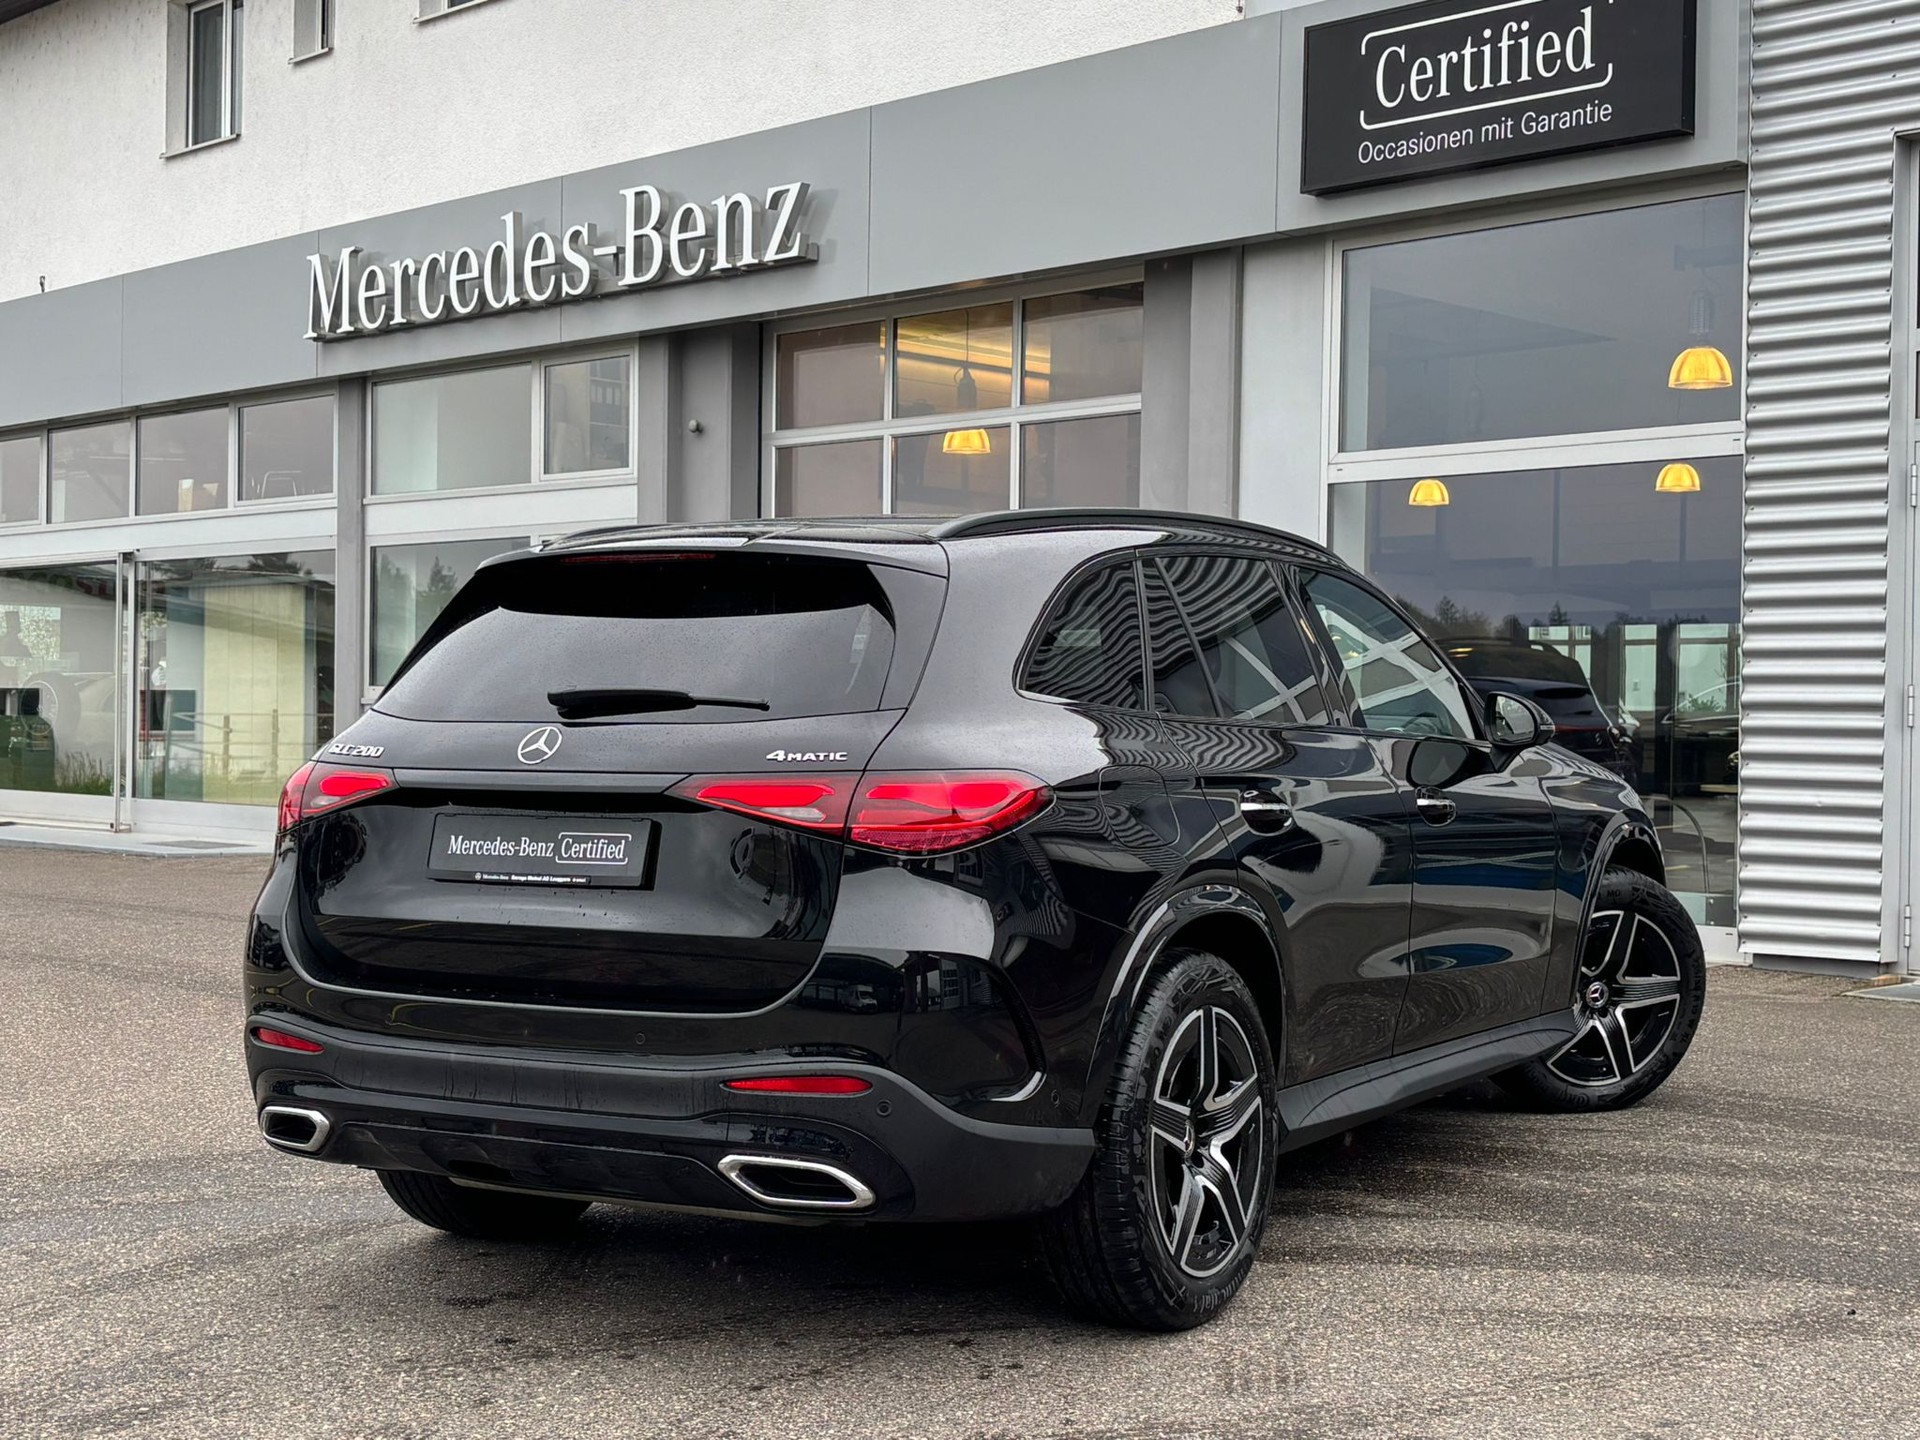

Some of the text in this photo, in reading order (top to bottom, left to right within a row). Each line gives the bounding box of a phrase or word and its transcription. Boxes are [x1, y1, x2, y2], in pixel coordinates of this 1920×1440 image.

[1375, 5, 1596, 109] Certified
[1358, 100, 1613, 164] Occasionen mit Garantie
[302, 181, 806, 340] Mercedes-Benz
[765, 749, 848, 762] 4MATIC
[447, 834, 626, 860] Mercedes-Benz Certified
